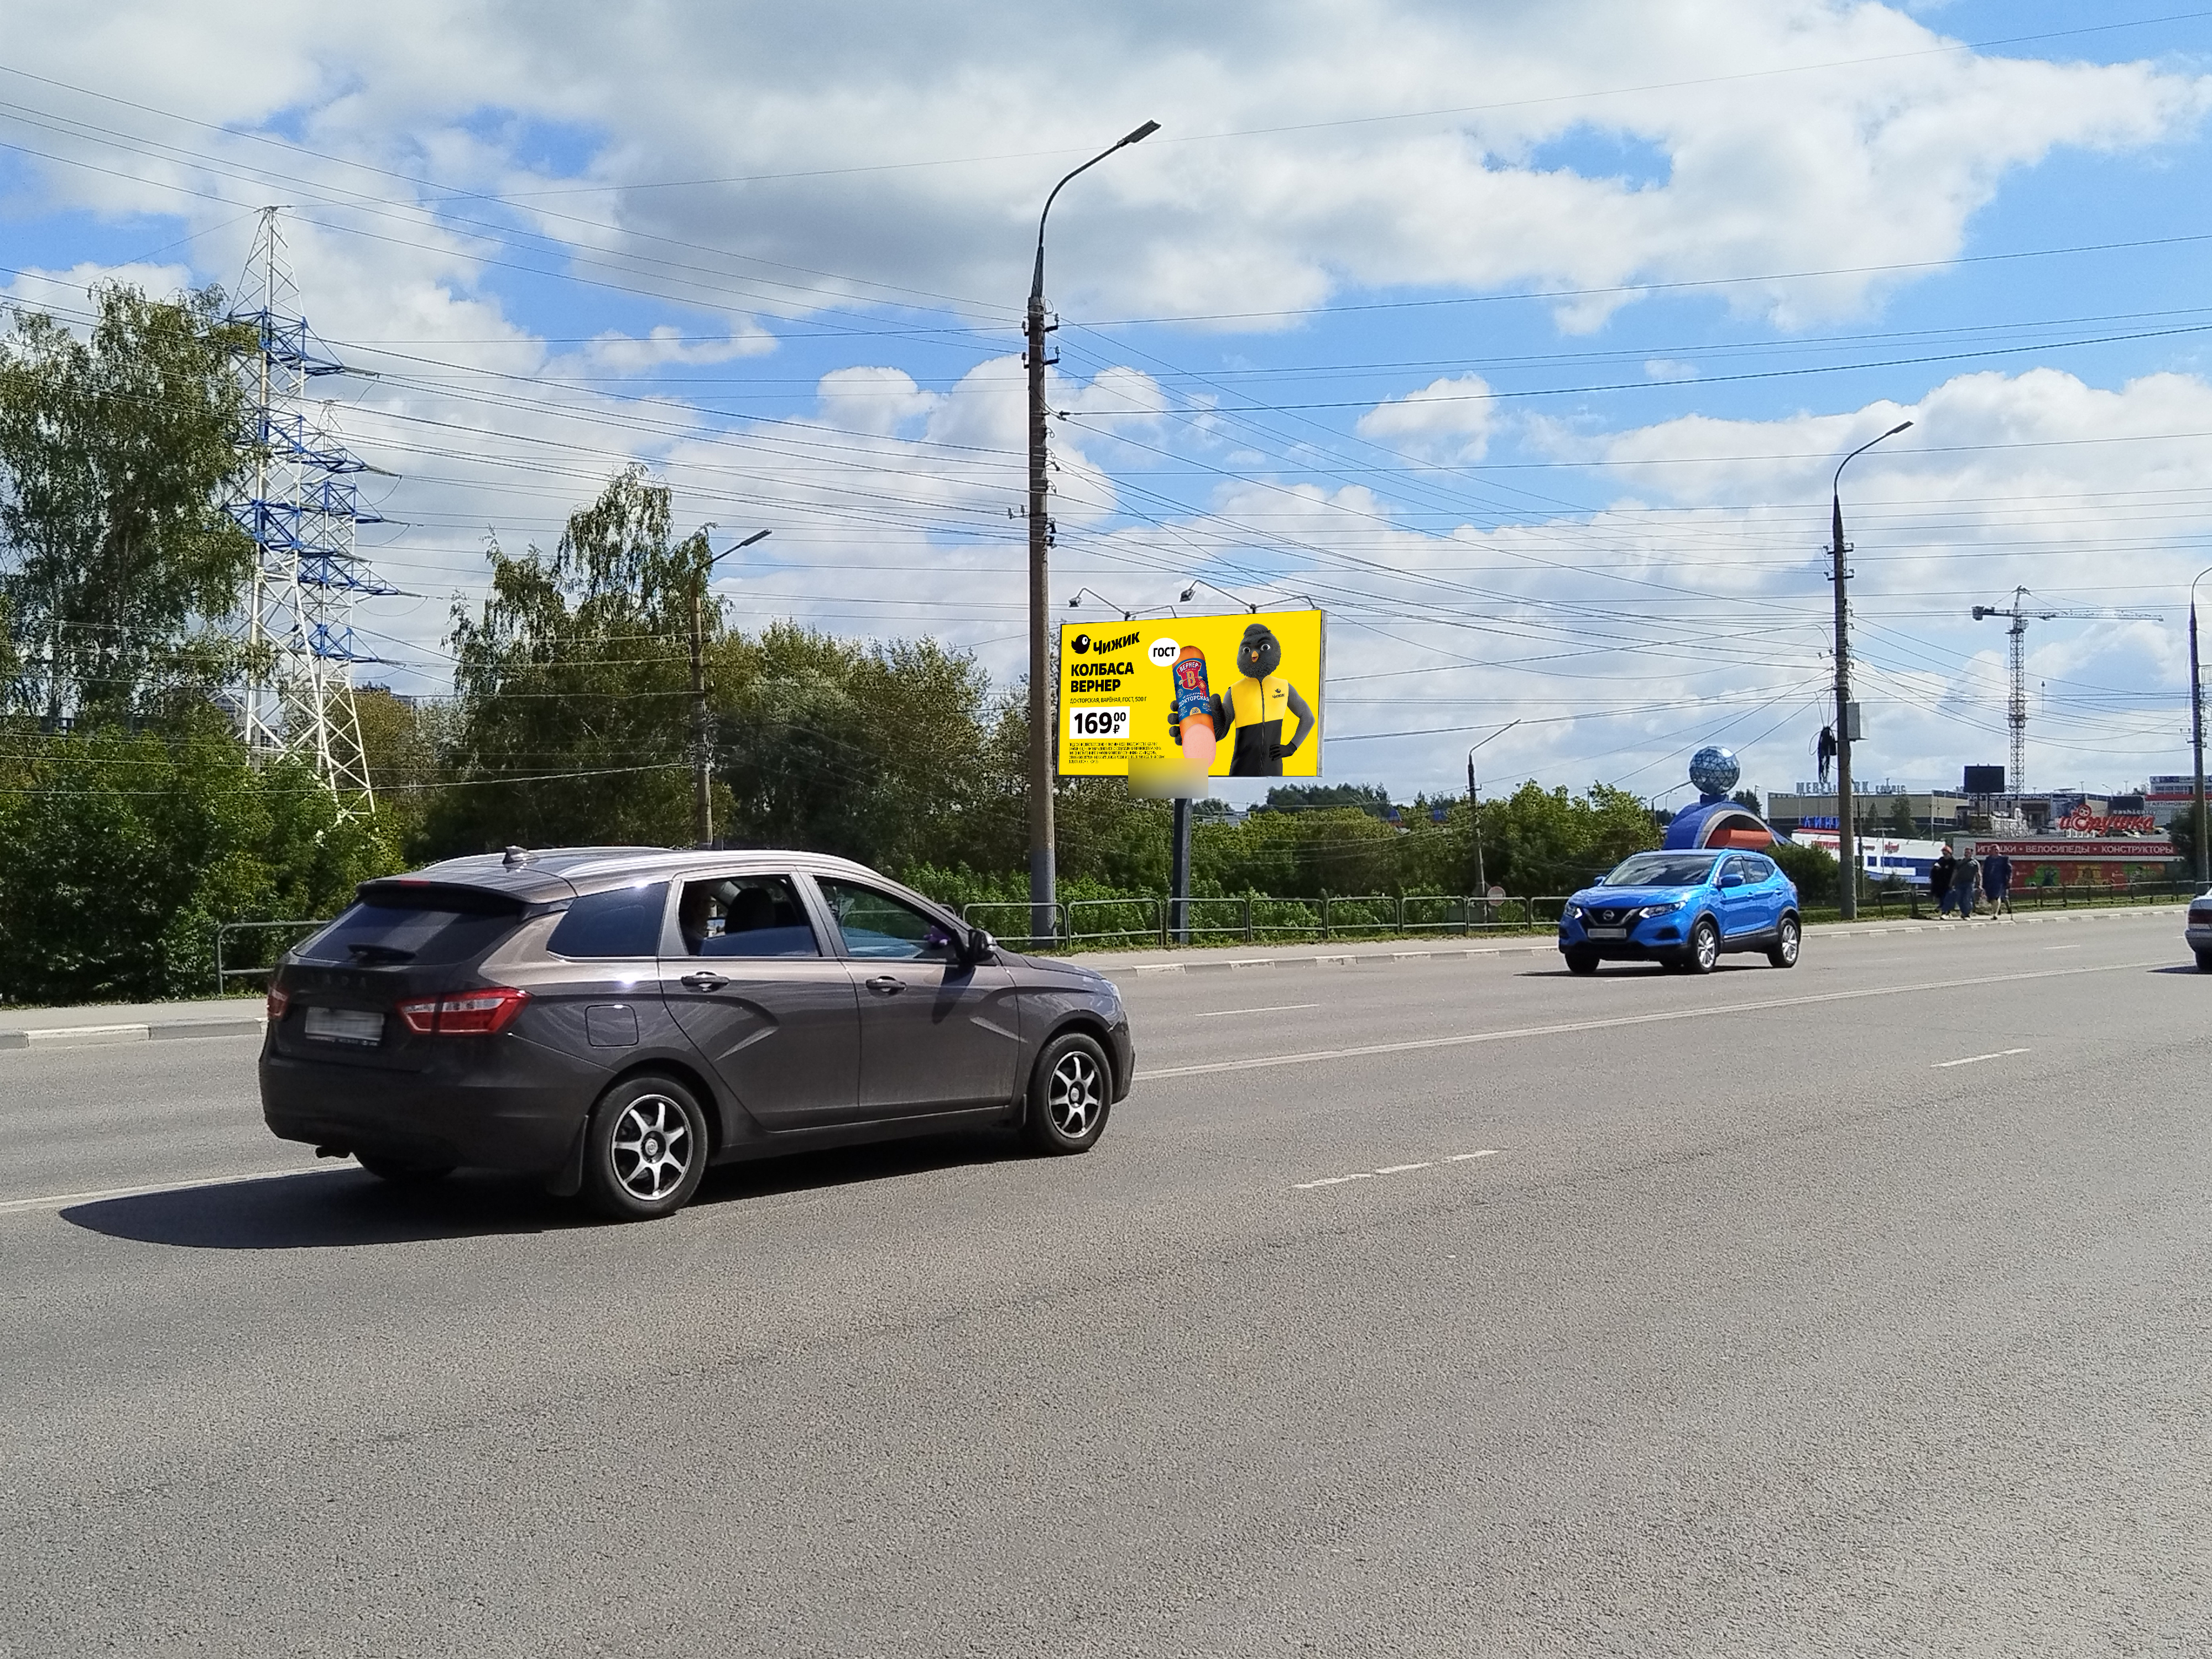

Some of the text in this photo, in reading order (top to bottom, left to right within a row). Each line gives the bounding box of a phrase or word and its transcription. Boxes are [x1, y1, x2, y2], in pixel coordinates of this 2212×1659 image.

[1093, 632, 1140, 655] Чижик
[1153, 647, 1176, 657] ГОСТ
[1071, 662, 1134, 676] КОЛБАСА
[1180, 662, 1199, 672] ВЕРНЕР
[1071, 679, 1121, 692] ВЕРНЕР
[1178, 695, 1209, 708] ДОКТОРСКАЯ
[1074, 712, 1126, 734] 169 00
[2026, 845, 2090, 854] ВЕЛОСИПЕДЫ
[2101, 845, 2173, 854] КОНСТРУКТОРЫ
